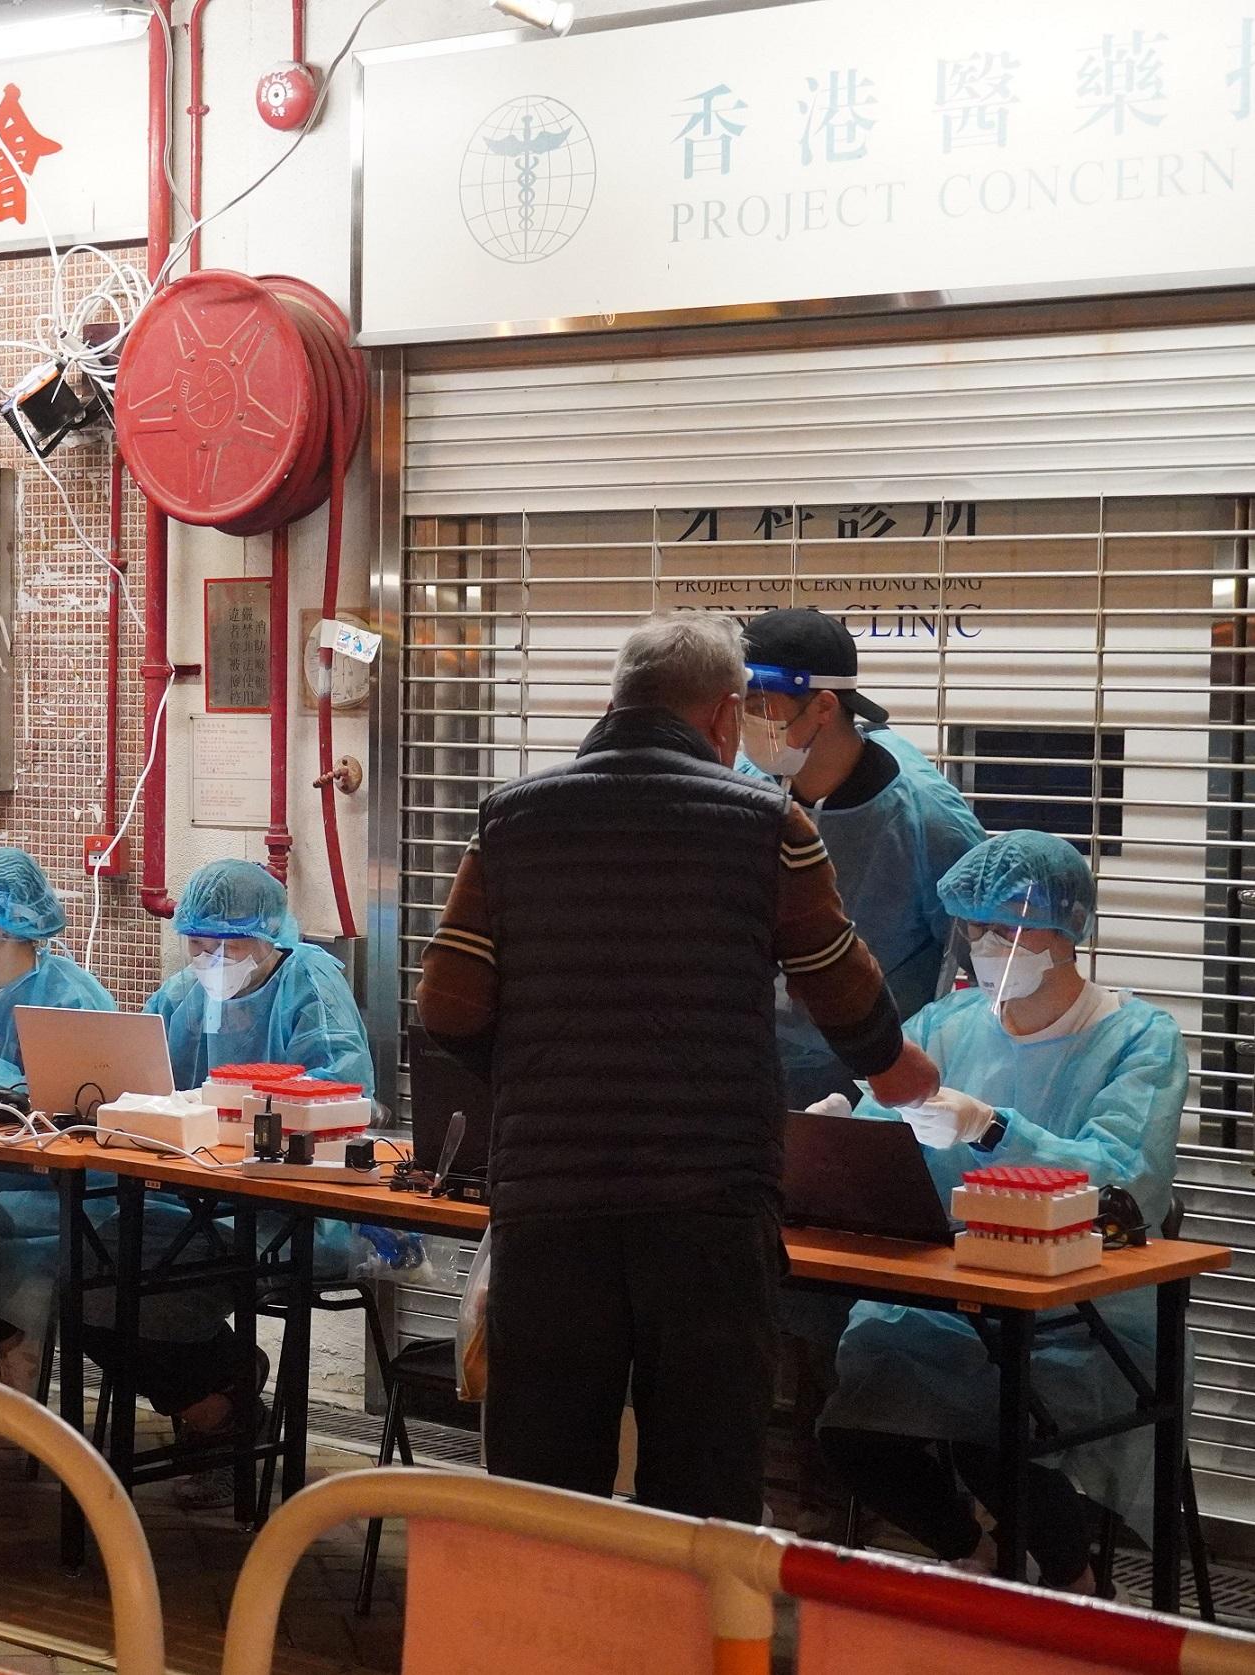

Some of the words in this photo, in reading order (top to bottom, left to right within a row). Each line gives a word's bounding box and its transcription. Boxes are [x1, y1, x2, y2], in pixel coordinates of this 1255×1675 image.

[669, 17, 1255, 181] 香港醫藥
[668, 180, 907, 244] PROJECT
[936, 146, 1239, 218] CONCERN
[674, 580, 752, 595] PROJECT
[759, 579, 852, 592] CONCERN
[859, 578, 917, 592] HONG
[923, 577, 983, 591] KONG
[840, 603, 983, 639] CLINIC
